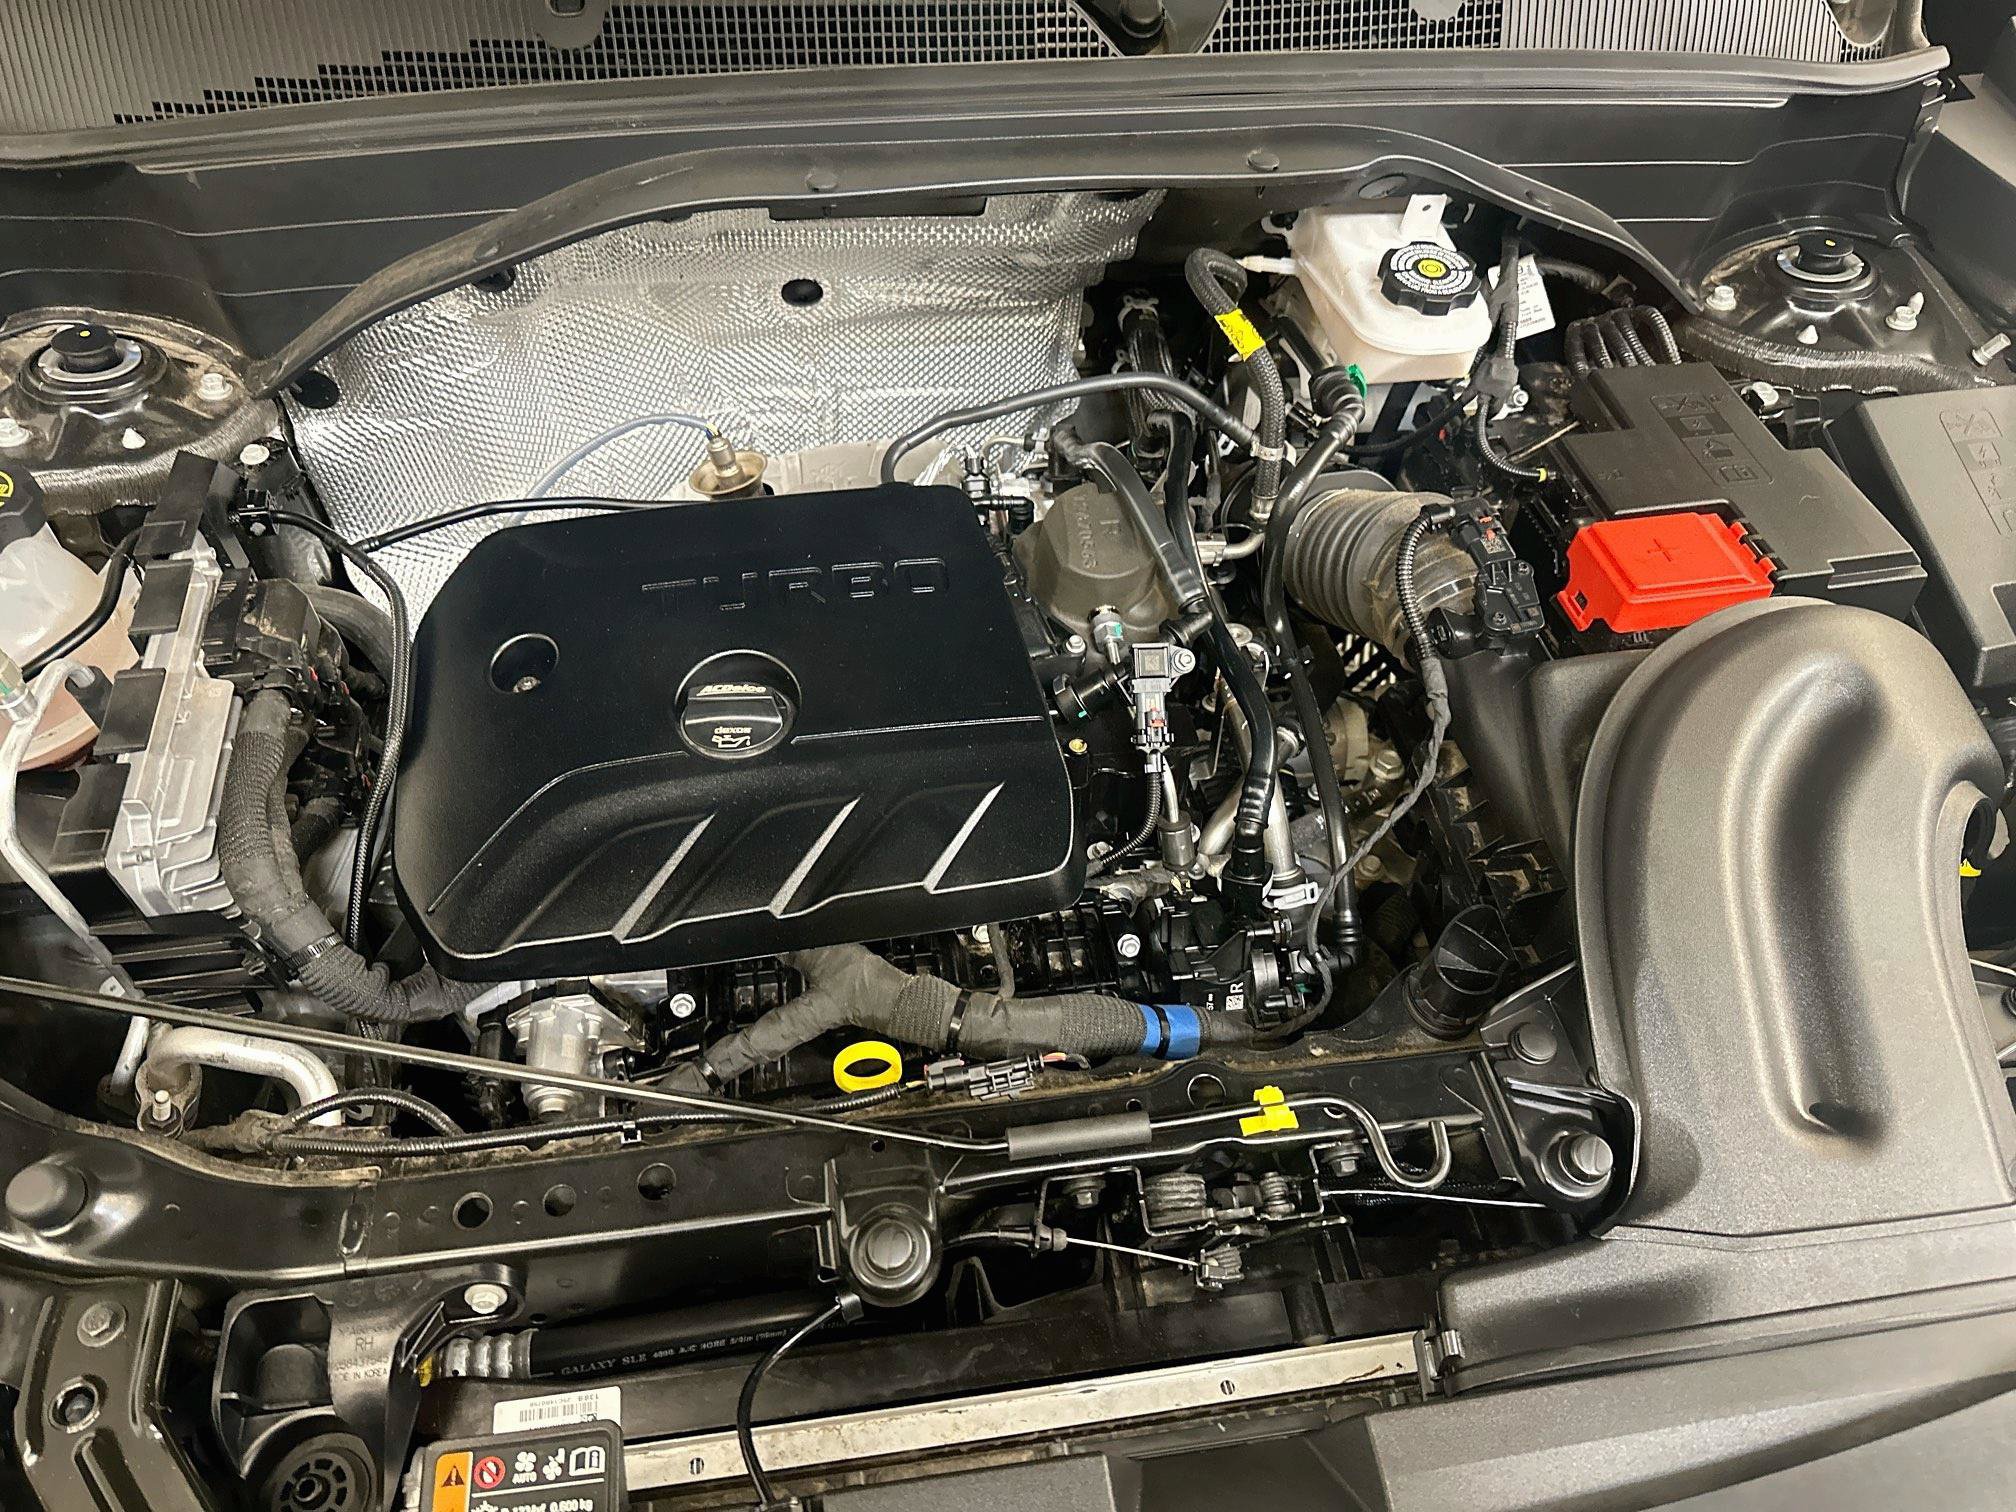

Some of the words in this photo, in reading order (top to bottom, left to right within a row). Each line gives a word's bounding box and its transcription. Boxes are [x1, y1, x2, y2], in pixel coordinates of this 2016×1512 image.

[641, 557, 948, 612] TURBO
[696, 684, 767, 696] ACDelco
[714, 726, 752, 734] dexos
[1230, 982, 1243, 993] R
[355, 1335, 374, 1352] RH
[561, 1358, 617, 1375] GALAXY
[622, 1353, 647, 1366] SLE
[364, 1367, 388, 1378] KOREA
[512, 1471, 538, 1485] AUTO
[579, 1498, 594, 1512] kg
